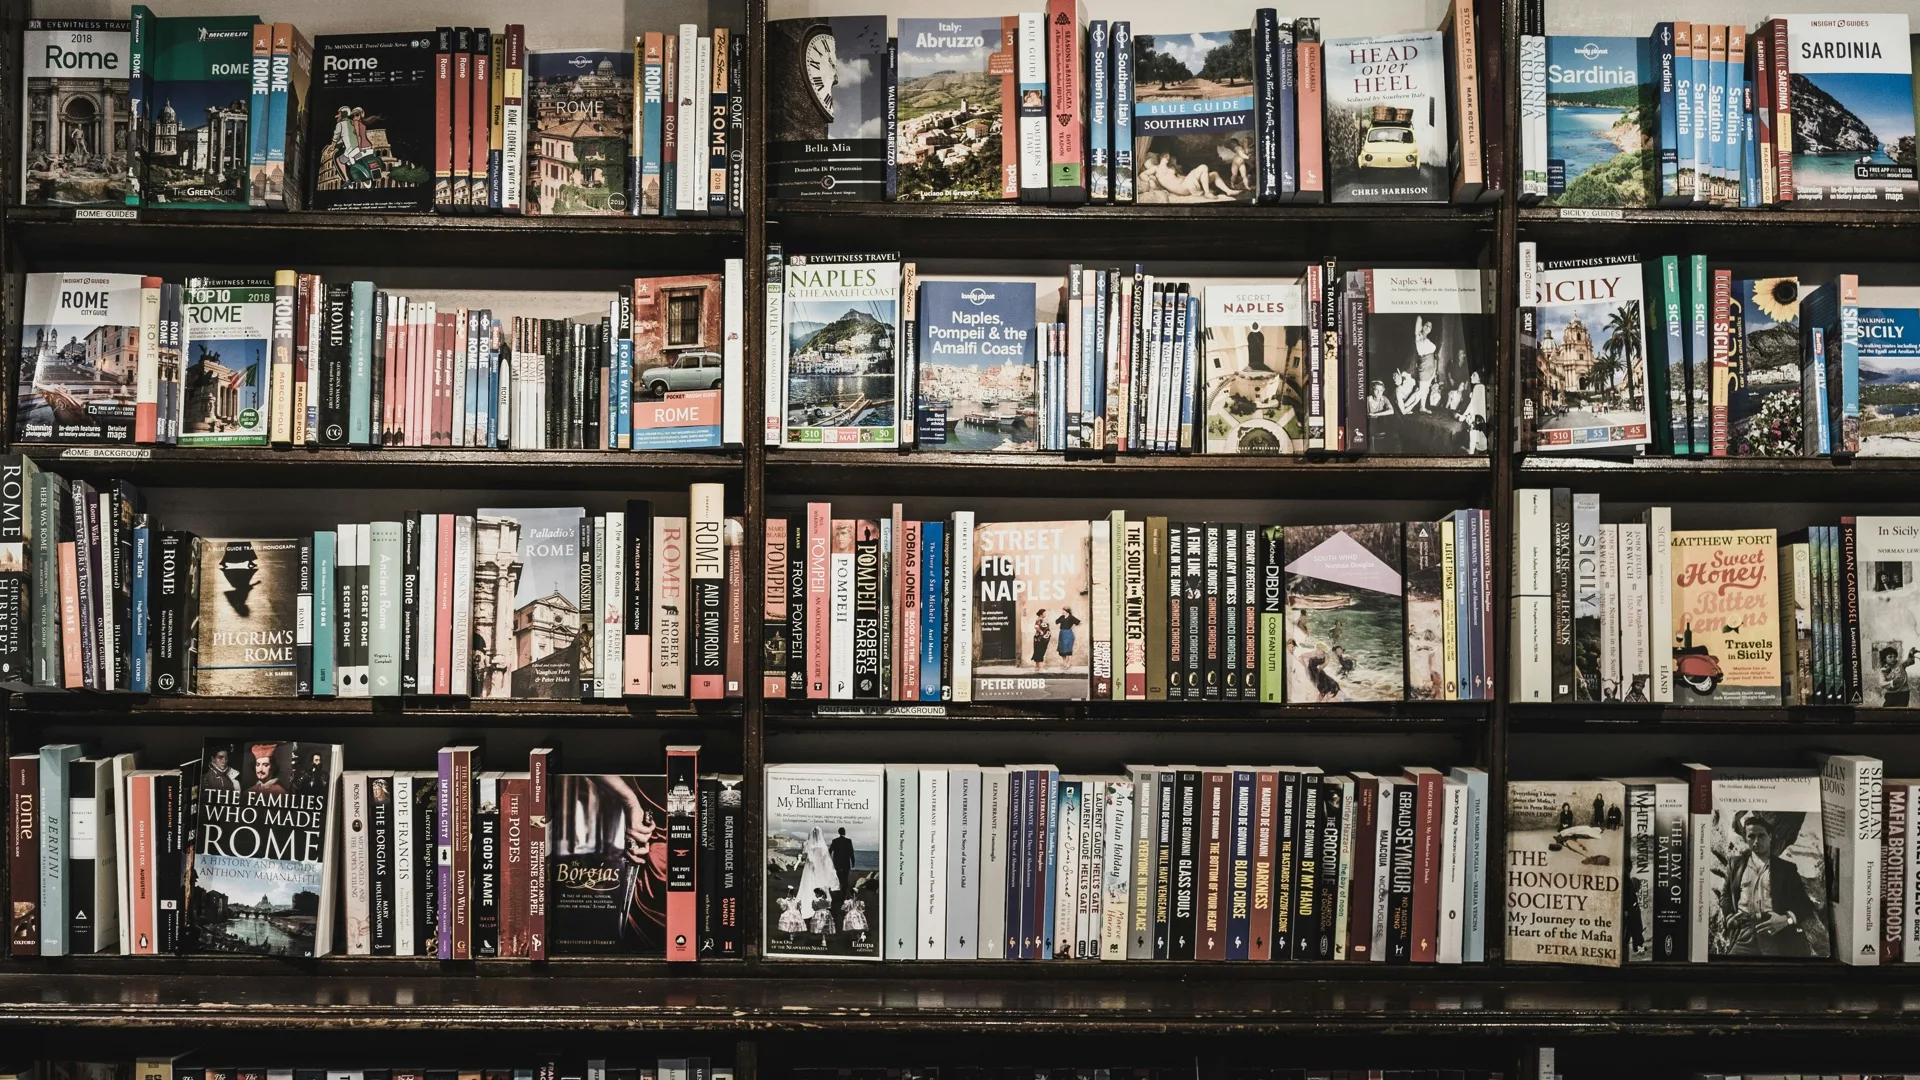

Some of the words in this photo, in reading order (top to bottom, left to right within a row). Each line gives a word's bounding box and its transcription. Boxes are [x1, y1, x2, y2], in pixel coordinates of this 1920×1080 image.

[208, 30, 248, 38] MICHELIN
[939, 23, 962, 33] Italy:
[1463, 8, 1471, 44] STOLEN
[71, 34, 92, 43] 2018
[916, 33, 984, 48] Abruzzo
[45, 45, 118, 70] Rome
[1350, 46, 1418, 64] HEAD
[1802, 42, 1882, 59] SARDINIA
[212, 63, 249, 75] ROME
[323, 55, 378, 71] Rome
[1362, 63, 1409, 75] over
[252, 58, 268, 96] ROME
[1354, 75, 1417, 94] HEEL
[1549, 65, 1636, 84] Sardinia
[556, 101, 604, 113] ROME
[1151, 103, 1188, 114] BLUE
[1193, 100, 1239, 112] GUIDE
[713, 106, 725, 156] ROME
[888, 121, 895, 130] IN
[1144, 118, 1210, 130] SOUTHERN
[1213, 115, 1245, 127] ITALY
[805, 143, 828, 153] Bella
[832, 143, 851, 152] Mia
[887, 131, 895, 166] ABRUZZO
[1352, 188, 1378, 196] CHRIS
[1381, 187, 1428, 195] HARRISON
[77, 210, 103, 218] ROME:
[105, 210, 135, 218] GUIDES
[1592, 210, 1621, 218] GUIDES
[811, 255, 863, 263] EYEWITNESS
[865, 254, 897, 262] TRAVEL
[790, 269, 876, 288] NAPLES
[1390, 277, 1418, 286] Naples
[62, 292, 109, 308] ROME
[249, 293, 270, 302] 2018
[1224, 303, 1285, 313] NAPLES
[188, 306, 242, 323] ROME
[275, 295, 292, 338] ROME
[331, 301, 343, 346] ROME
[952, 311, 1004, 326] Naples,
[1669, 304, 1680, 338] SICILY
[929, 327, 985, 340] Pompeii
[989, 328, 1000, 340] &
[1003, 328, 1027, 339] the
[1713, 323, 1728, 365] SICILY
[932, 342, 977, 355] Amalfi
[981, 342, 1022, 355] Coast
[620, 344, 628, 375] ROME
[620, 378, 628, 415] WALKS
[654, 407, 699, 422] ROME
[1553, 432, 1568, 440] 510
[2, 465, 21, 537] ROME
[529, 528, 574, 538] Palladio's
[981, 529, 1064, 551] STREET
[1128, 528, 1140, 547] THE
[1879, 526, 1889, 536] In
[1892, 526, 1919, 537] Sicily
[526, 545, 574, 557] ROME
[695, 522, 719, 574] ROME
[662, 528, 680, 599] ROME
[981, 555, 1044, 577] FIGHT
[1053, 554, 1075, 575] IN
[1128, 550, 1140, 583] SOUTH
[1711, 550, 1764, 568] Sweet
[767, 543, 785, 605] POMPEII
[792, 561, 803, 599] FROM
[1579, 534, 1596, 607] SICILY
[405, 574, 415, 604] Rome
[704, 583, 719, 607] AND
[981, 580, 1066, 602] NAPLES
[1266, 566, 1279, 611] DIBDIN
[9, 578, 19, 653] CHRISTOPHER
[1127, 597, 1141, 640] WINTER
[213, 630, 293, 646] PILGRIM'S
[704, 612, 719, 667] ENVIRONS
[792, 603, 803, 659] POMPEII
[661, 619, 669, 667] HUGHES
[670, 622, 679, 666] ROBERT
[856, 618, 866, 674] HARRIS
[866, 619, 877, 674] ROBERT
[1725, 640, 1773, 649] Travels
[244, 648, 293, 661] ROME
[1728, 652, 1736, 660] in
[1737, 650, 1773, 661] Sicily
[981, 679, 1014, 690] PETER
[1017, 678, 1045, 689] ROBB
[205, 789, 240, 805] THE
[247, 791, 323, 810] FAMILIES
[398, 782, 408, 817] POPE
[790, 785, 815, 796] Elena
[818, 786, 856, 797] Ferrante
[777, 797, 794, 810] My
[796, 798, 833, 810] Brilliant
[836, 798, 869, 810] Friend
[1859, 767, 1869, 840] SHADOWS
[1871, 767, 1883, 840] SICILIAN
[1888, 791, 1905, 834] MAFIA
[20, 794, 33, 840] rome
[205, 805, 257, 824] WHO
[264, 810, 320, 828] MADE
[376, 804, 384, 825] THE
[483, 821, 493, 833] IN
[48, 816, 59, 879] BERNINI
[203, 824, 320, 863] ROME
[376, 828, 386, 876] BORGIAS
[399, 822, 409, 880] FRANCIS
[483, 836, 493, 870] GOD'S
[1508, 850, 1548, 867] THE
[557, 862, 620, 882] Borgias
[1178, 860, 1192, 888] GLASS
[1508, 871, 1619, 892] HONOURED
[483, 873, 493, 906] NAME
[1255, 862, 1270, 910] DARKNESS
[1886, 837, 1905, 942] BROTHERHOODS
[1177, 889, 1190, 918] SOULS
[1508, 892, 1588, 912] SOCIETY
[1537, 944, 1578, 957] PETRA
[1581, 948, 1617, 960] RESKI
